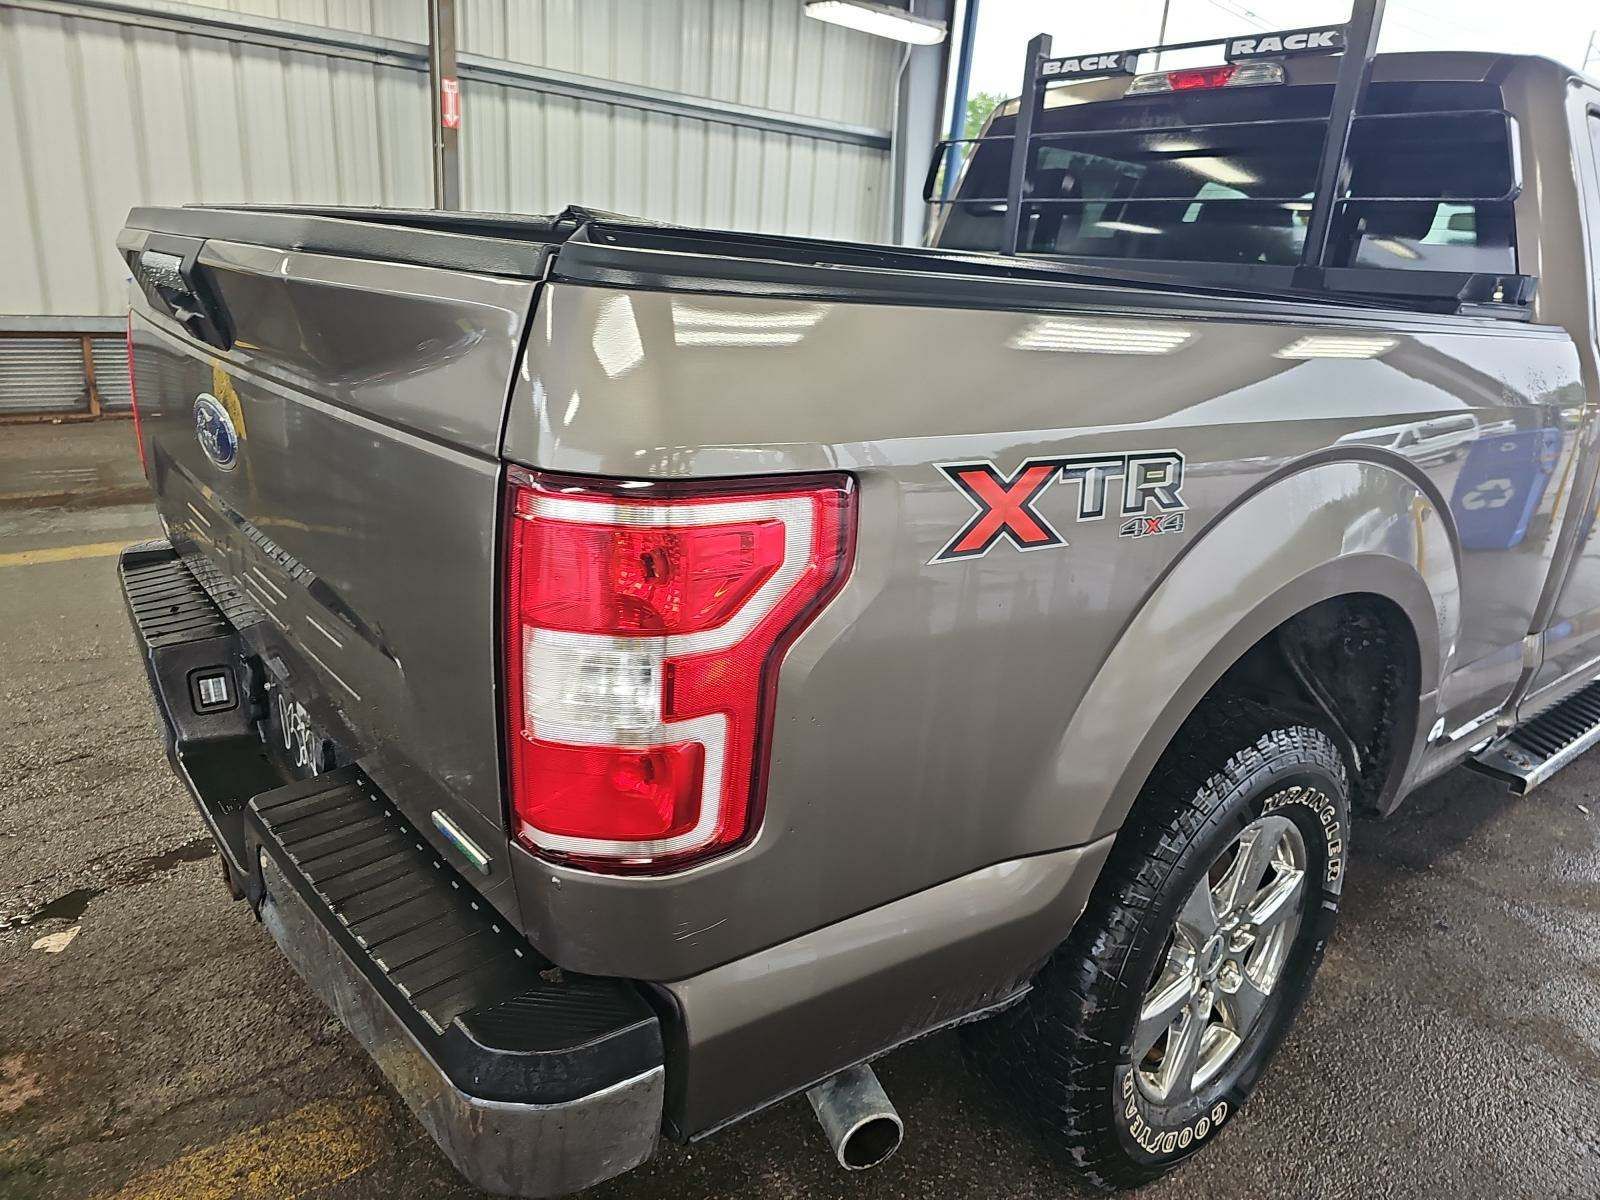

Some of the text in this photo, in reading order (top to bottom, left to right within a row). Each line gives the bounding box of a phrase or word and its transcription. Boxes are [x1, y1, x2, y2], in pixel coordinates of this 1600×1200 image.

[1042, 31, 1337, 75] BACK RACK
[926, 448, 1189, 565] XTR
[1260, 786, 1341, 882] WRANGLER
[1123, 1068, 1228, 1153] GOODYEAR
